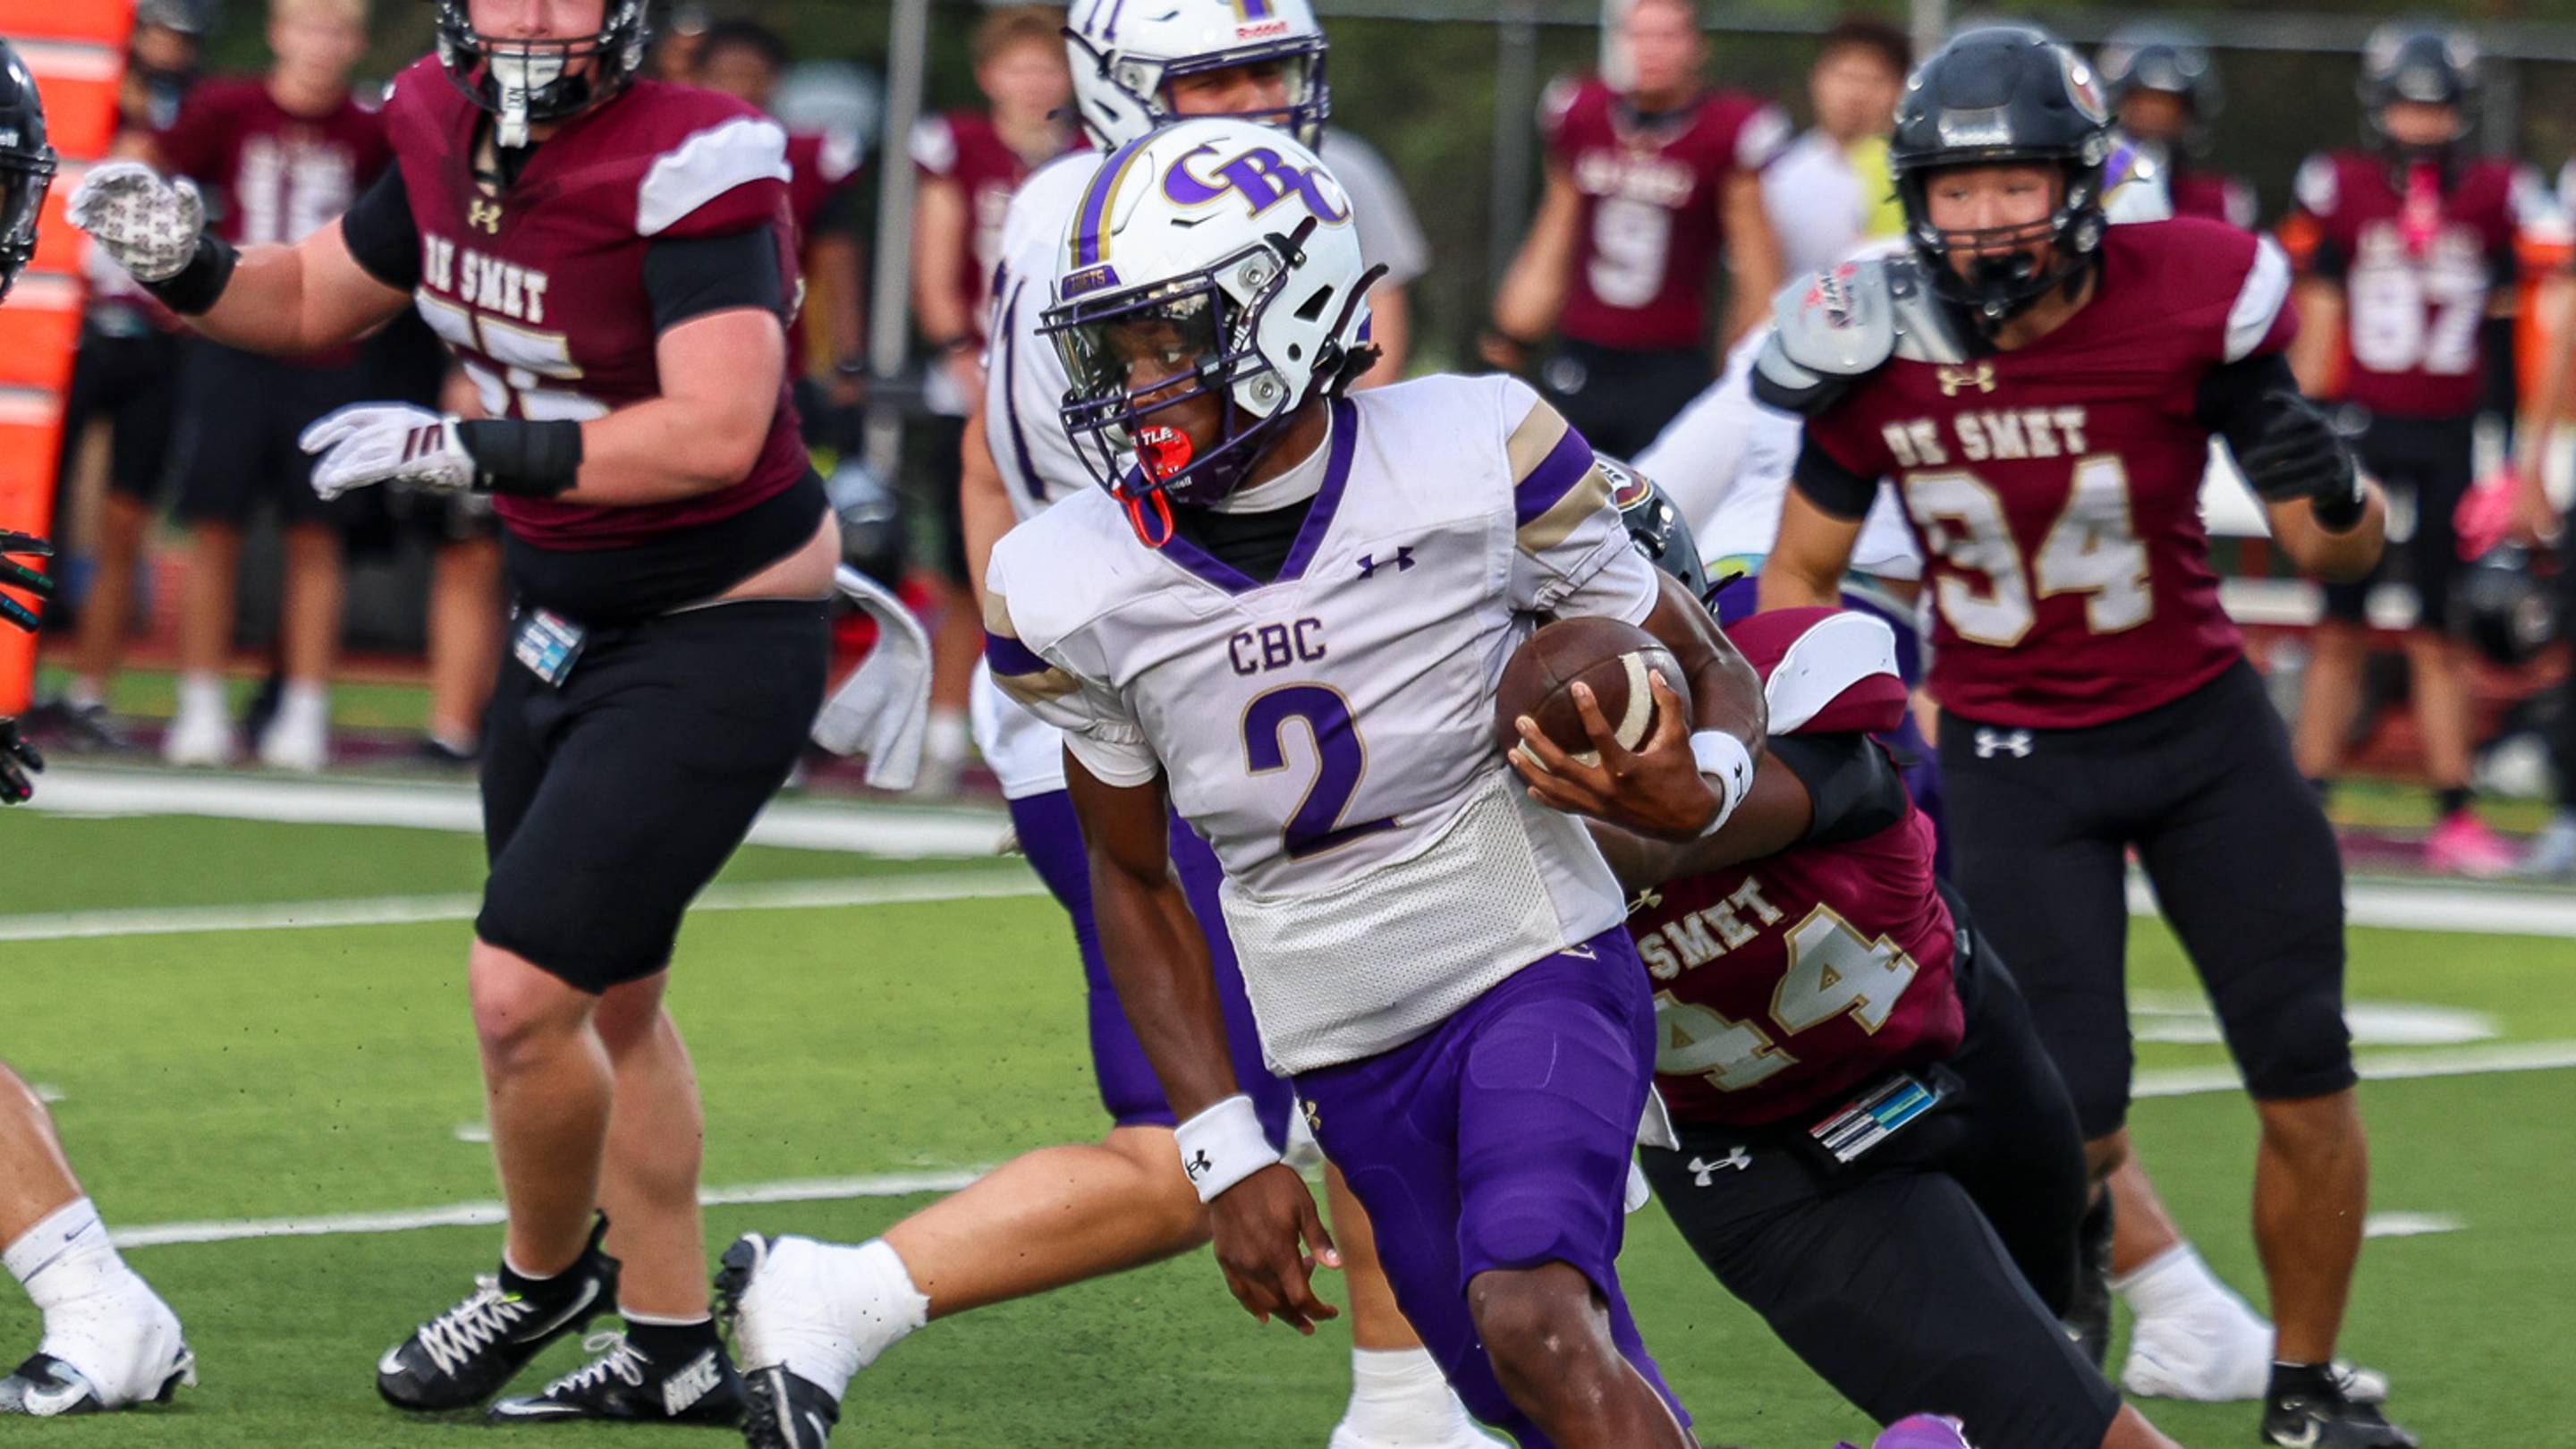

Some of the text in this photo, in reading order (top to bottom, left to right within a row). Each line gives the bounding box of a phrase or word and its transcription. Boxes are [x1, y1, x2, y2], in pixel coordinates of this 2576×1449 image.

[1159, 143, 1352, 228] CBC
[459, 248, 548, 324] SMET
[1953, 406, 2086, 461] SMET
[1228, 616, 1326, 677] CBC
[1239, 681, 1403, 864] 2
[1636, 876, 1784, 980] SMET
[1652, 902, 1920, 1093] 44
[663, 1349, 722, 1416] NIKE
